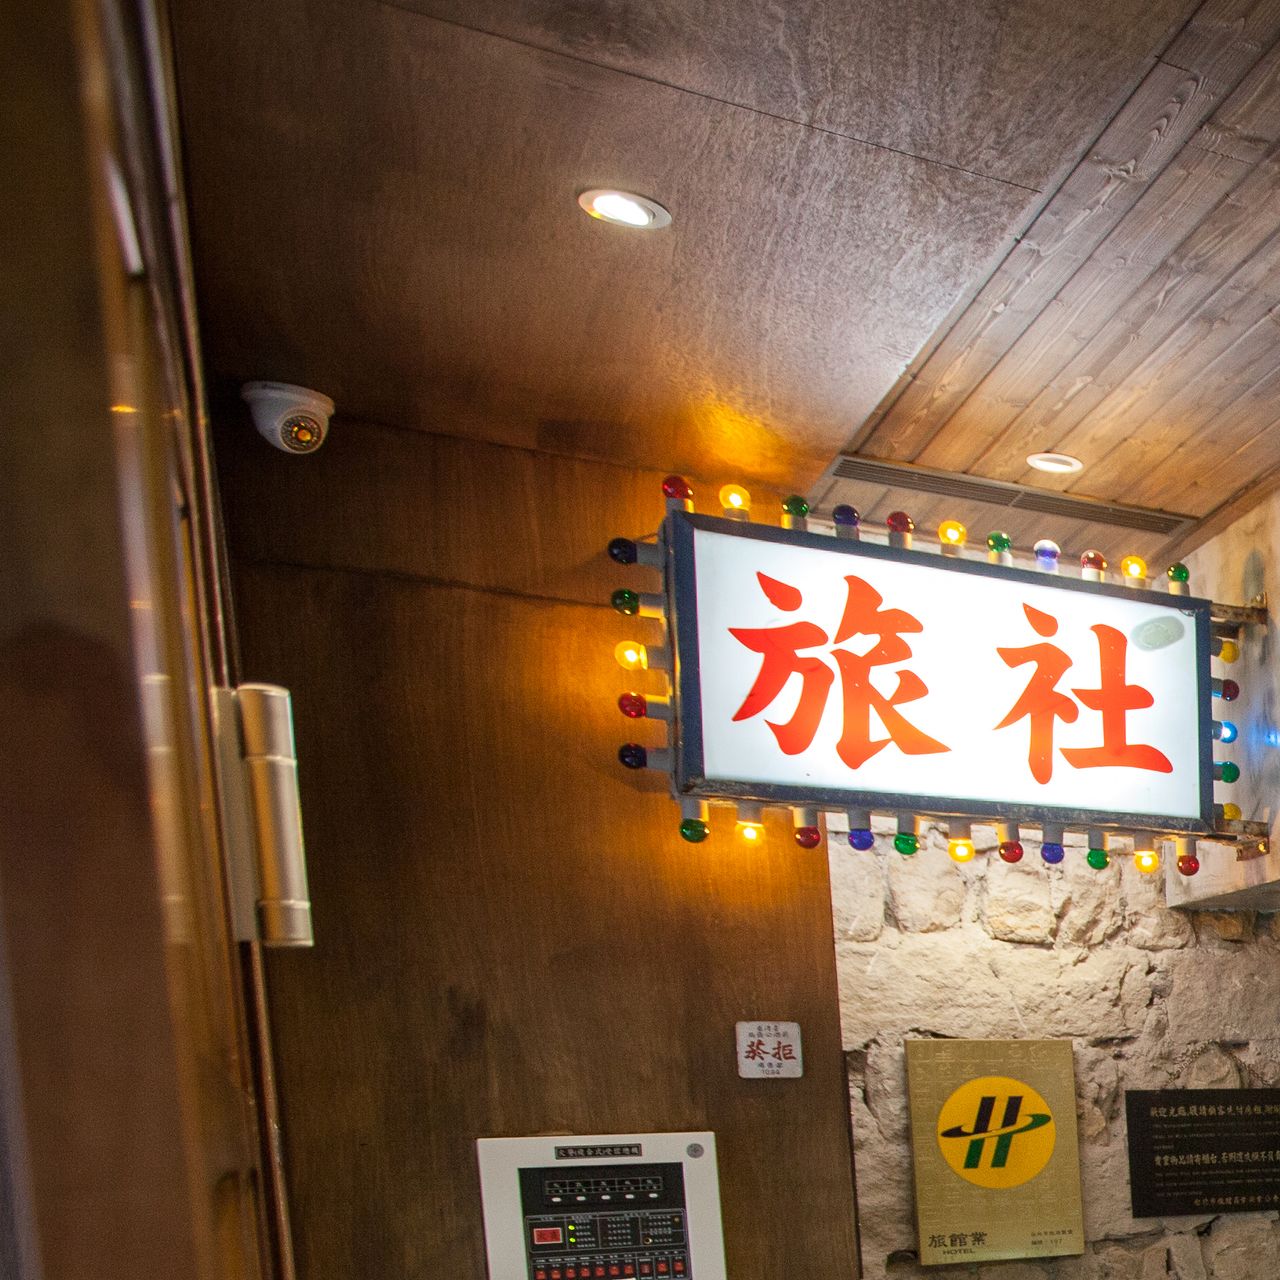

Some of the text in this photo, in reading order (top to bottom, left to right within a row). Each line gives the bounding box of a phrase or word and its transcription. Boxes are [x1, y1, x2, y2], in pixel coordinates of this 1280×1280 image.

[728, 571, 1173, 785] 旅社
[928, 1231, 988, 1249] 旅館業
